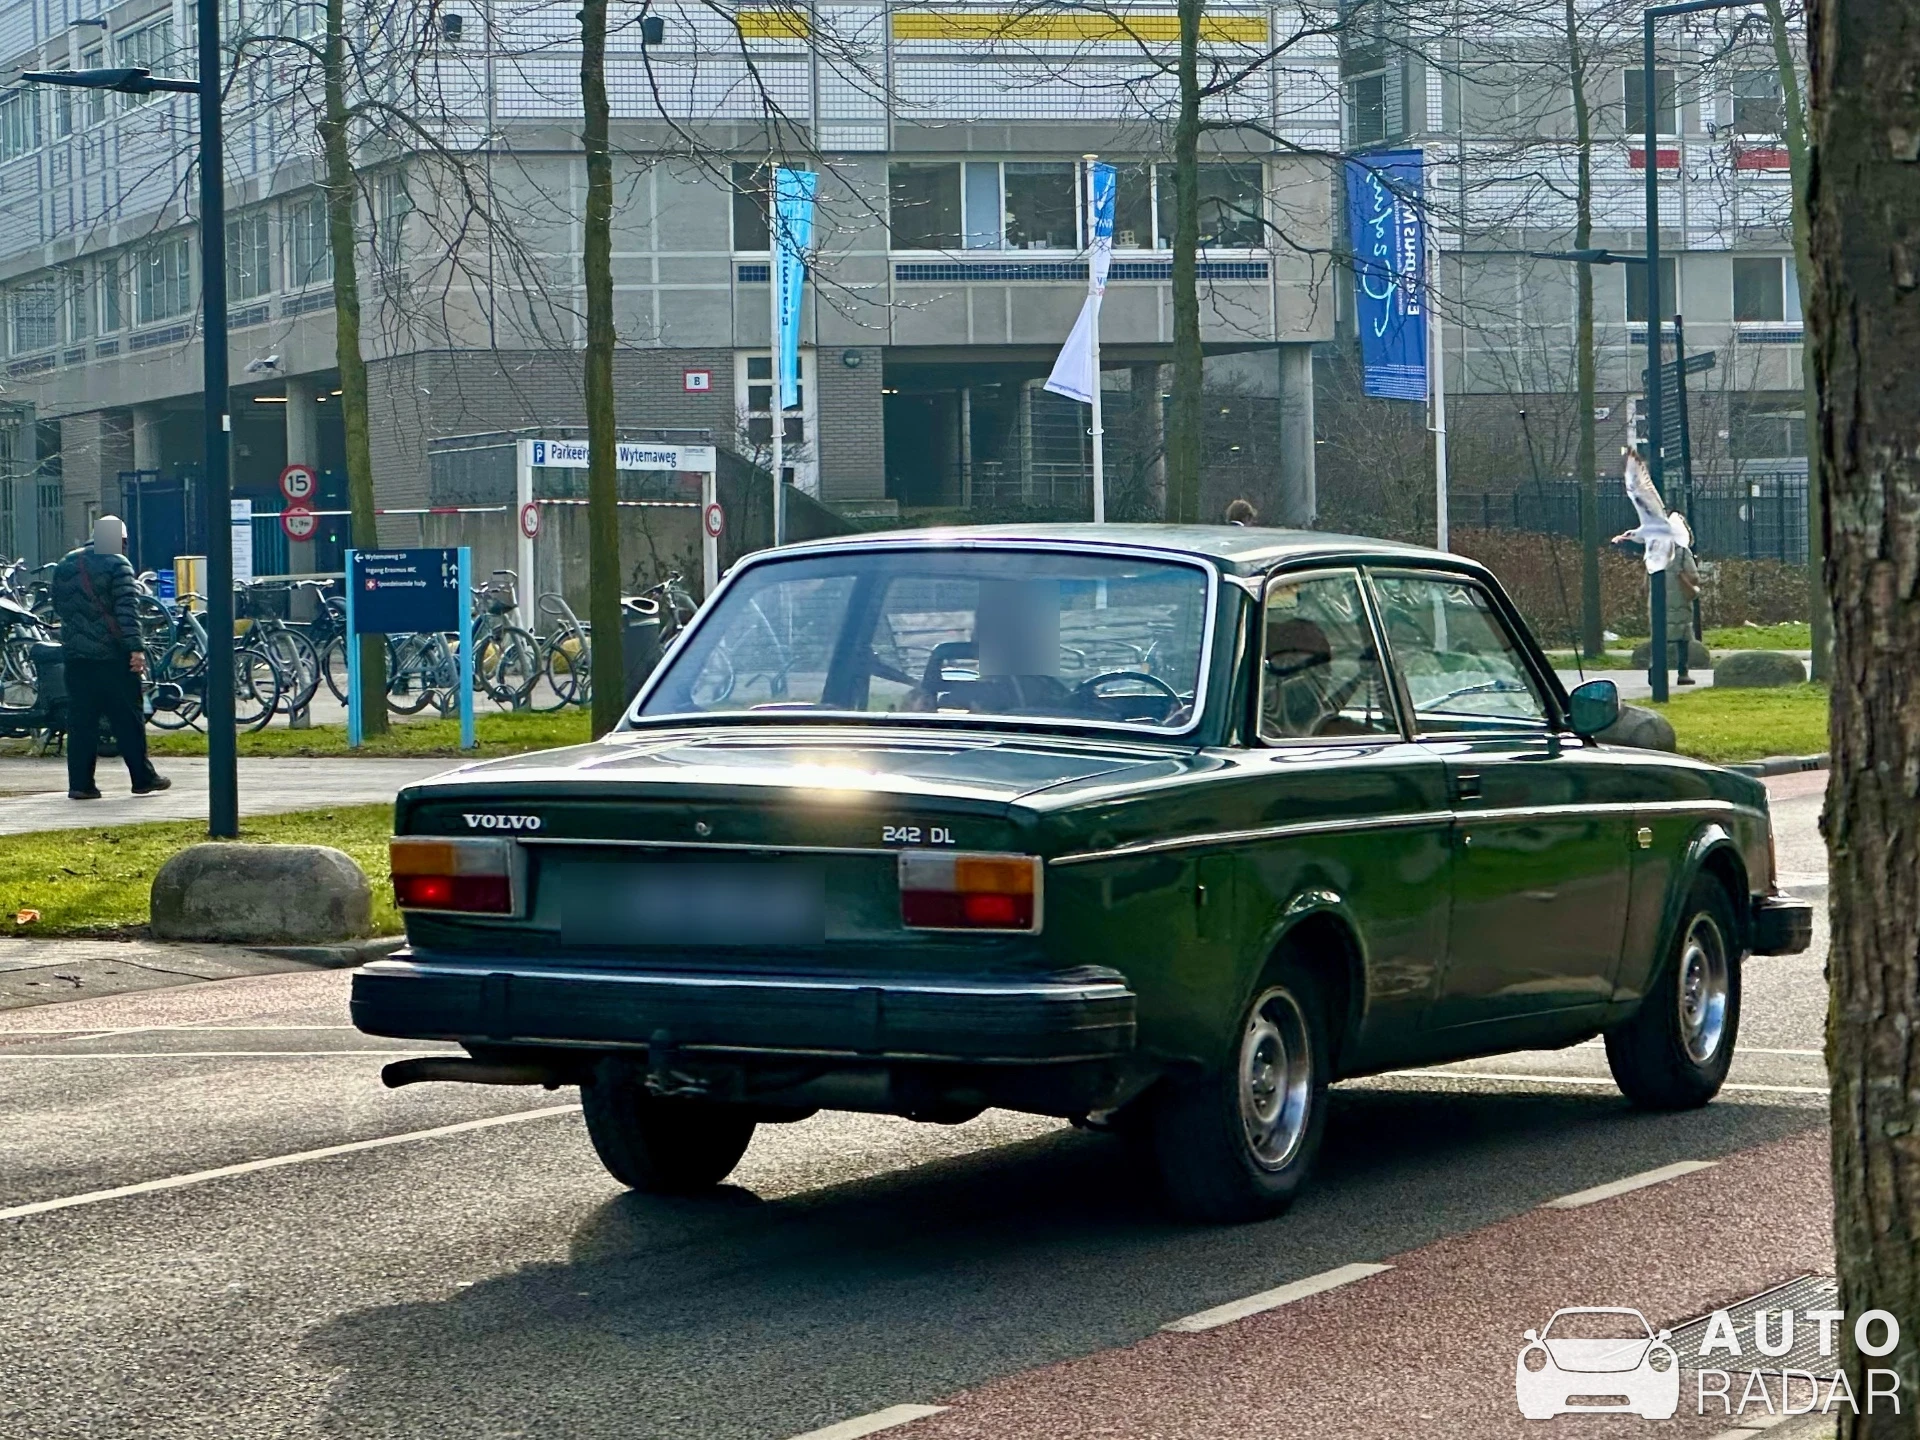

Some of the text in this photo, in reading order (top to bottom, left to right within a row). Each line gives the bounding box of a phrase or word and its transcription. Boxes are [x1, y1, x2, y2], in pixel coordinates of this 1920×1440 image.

[694, 377, 700, 385] B
[551, 444, 590, 465] Parkeer
[620, 446, 677, 468] Wytemaweg
[288, 475, 308, 492] 15
[365, 567, 384, 575] Ingang
[462, 813, 541, 830] VOLVO
[882, 825, 956, 843] 242 DL
